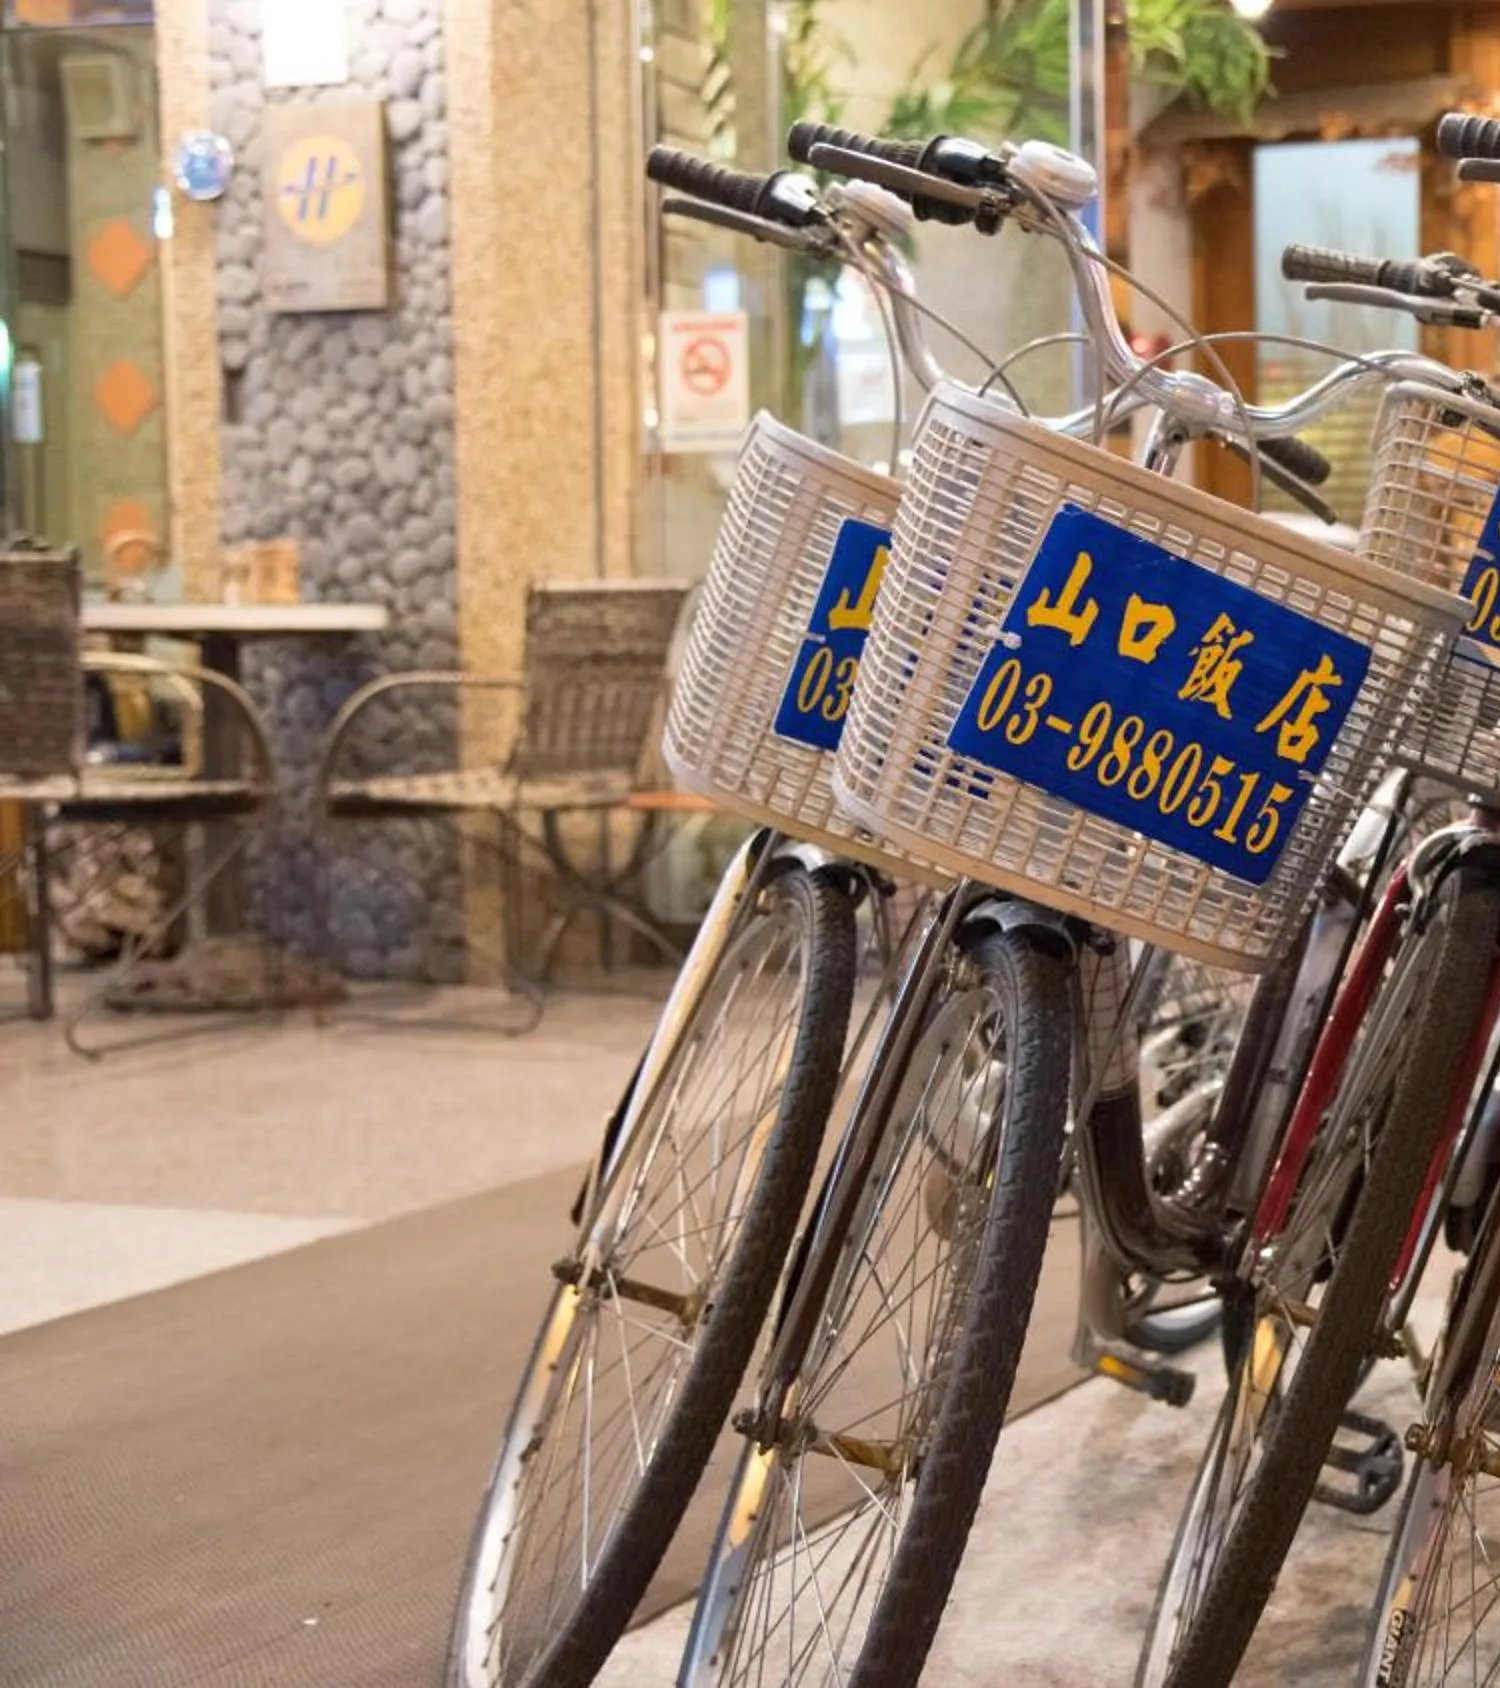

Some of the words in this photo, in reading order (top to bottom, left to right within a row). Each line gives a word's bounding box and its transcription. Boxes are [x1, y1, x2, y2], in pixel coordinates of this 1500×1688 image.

[976, 658, 1294, 855] 03-9880515
[1026, 550, 1342, 764] 山口飯店
